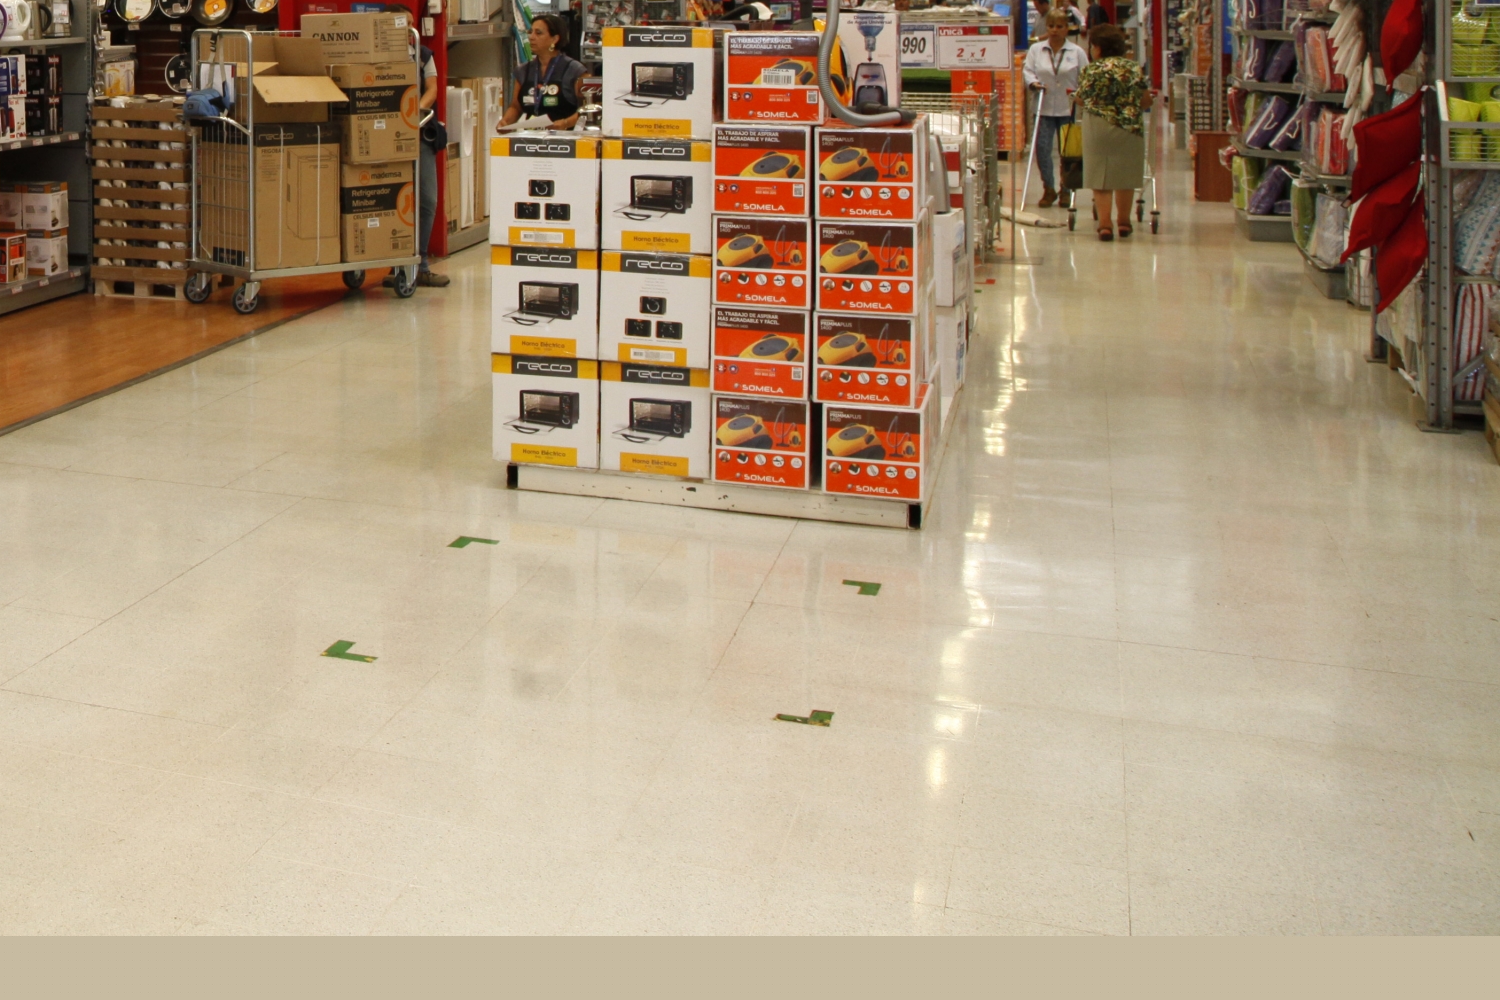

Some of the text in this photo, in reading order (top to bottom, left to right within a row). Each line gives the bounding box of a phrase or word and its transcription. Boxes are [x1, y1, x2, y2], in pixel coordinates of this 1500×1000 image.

[939, 27, 963, 35] única
[312, 31, 360, 42] CANNON
[957, 48, 964, 57] 2
[980, 48, 986, 56] 1
[356, 89, 395, 98] Refrigerador
[356, 100, 380, 108] Minibar
[515, 144, 570, 153] recco
[628, 146, 685, 156] recco
[371, 170, 402, 179] mademsa
[352, 186, 390, 198] Refrigerador
[351, 199, 376, 207] Minibar
